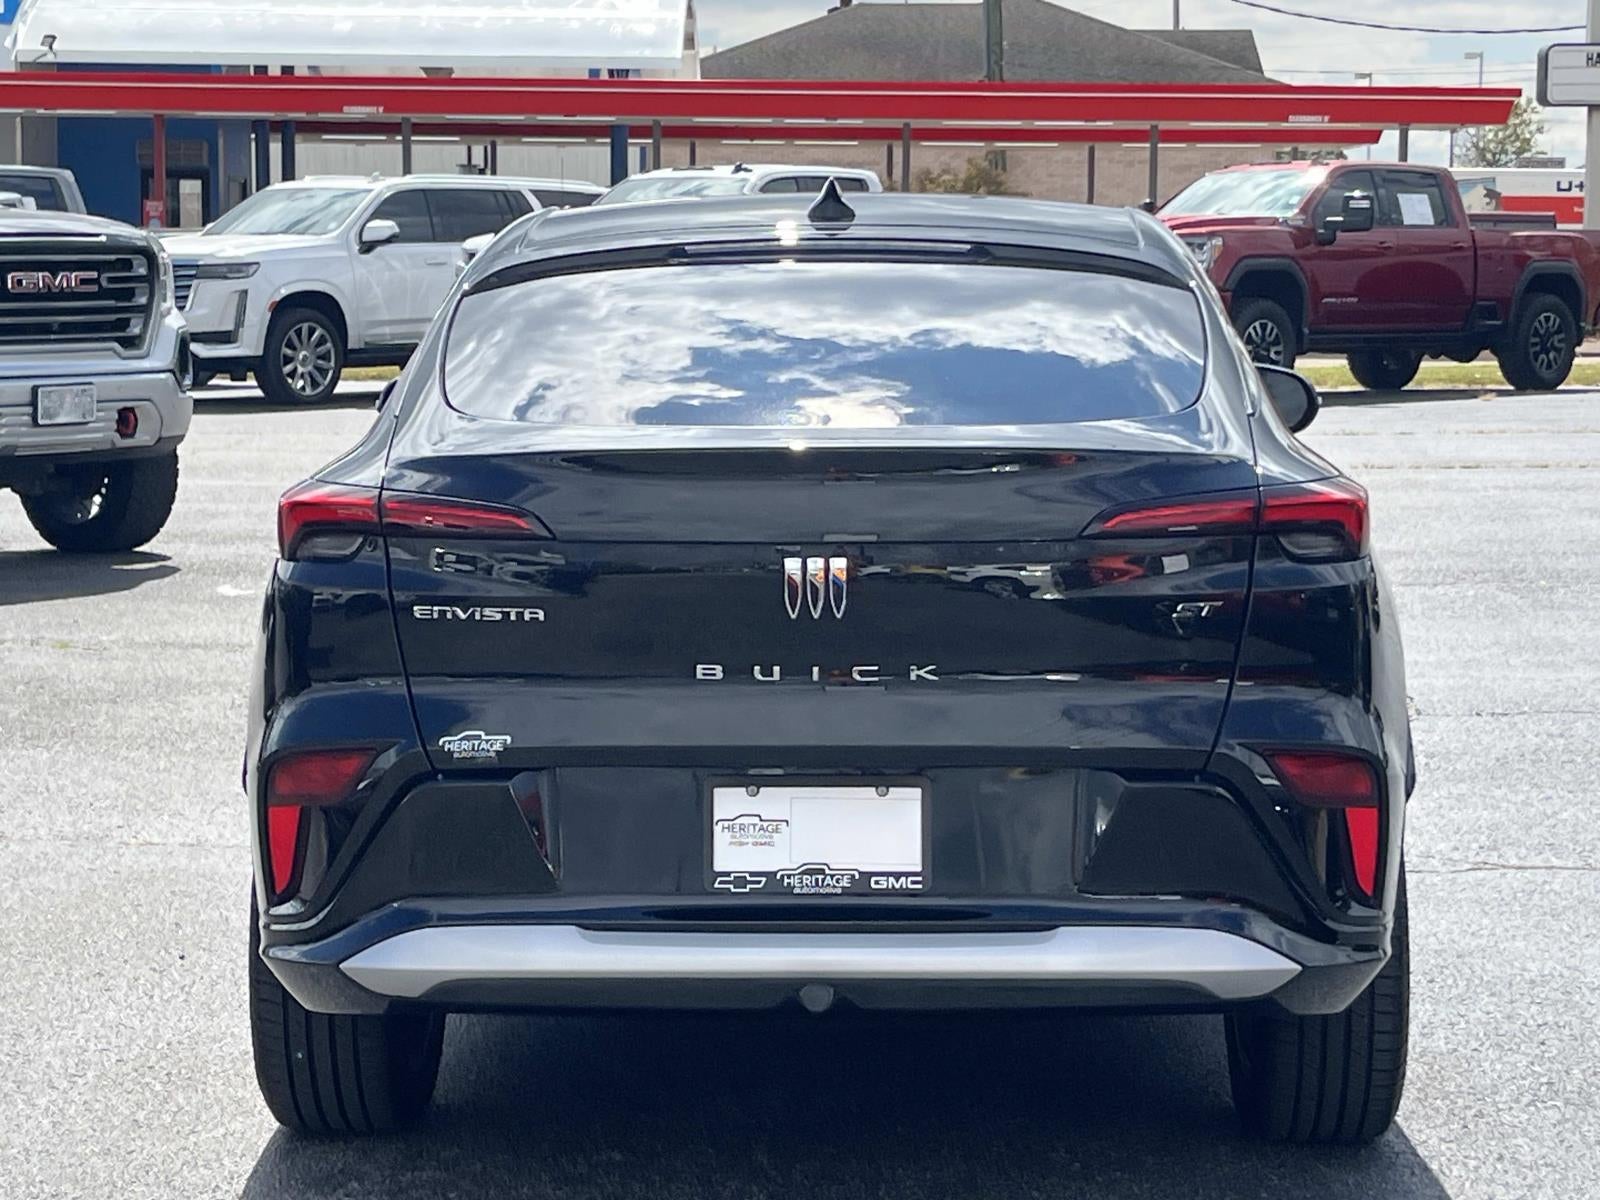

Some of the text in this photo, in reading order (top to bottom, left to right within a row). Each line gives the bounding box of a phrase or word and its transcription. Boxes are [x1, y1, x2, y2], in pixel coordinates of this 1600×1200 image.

[7, 271, 99, 293] GMC
[412, 605, 545, 621] ENVISTA
[696, 664, 939, 682] BUICK
[444, 740, 505, 752] HERITAGE
[721, 823, 783, 834] HERITAGE
[783, 875, 851, 887] HERITAGE
[870, 876, 922, 889] GMC
[792, 886, 842, 895] automotive
